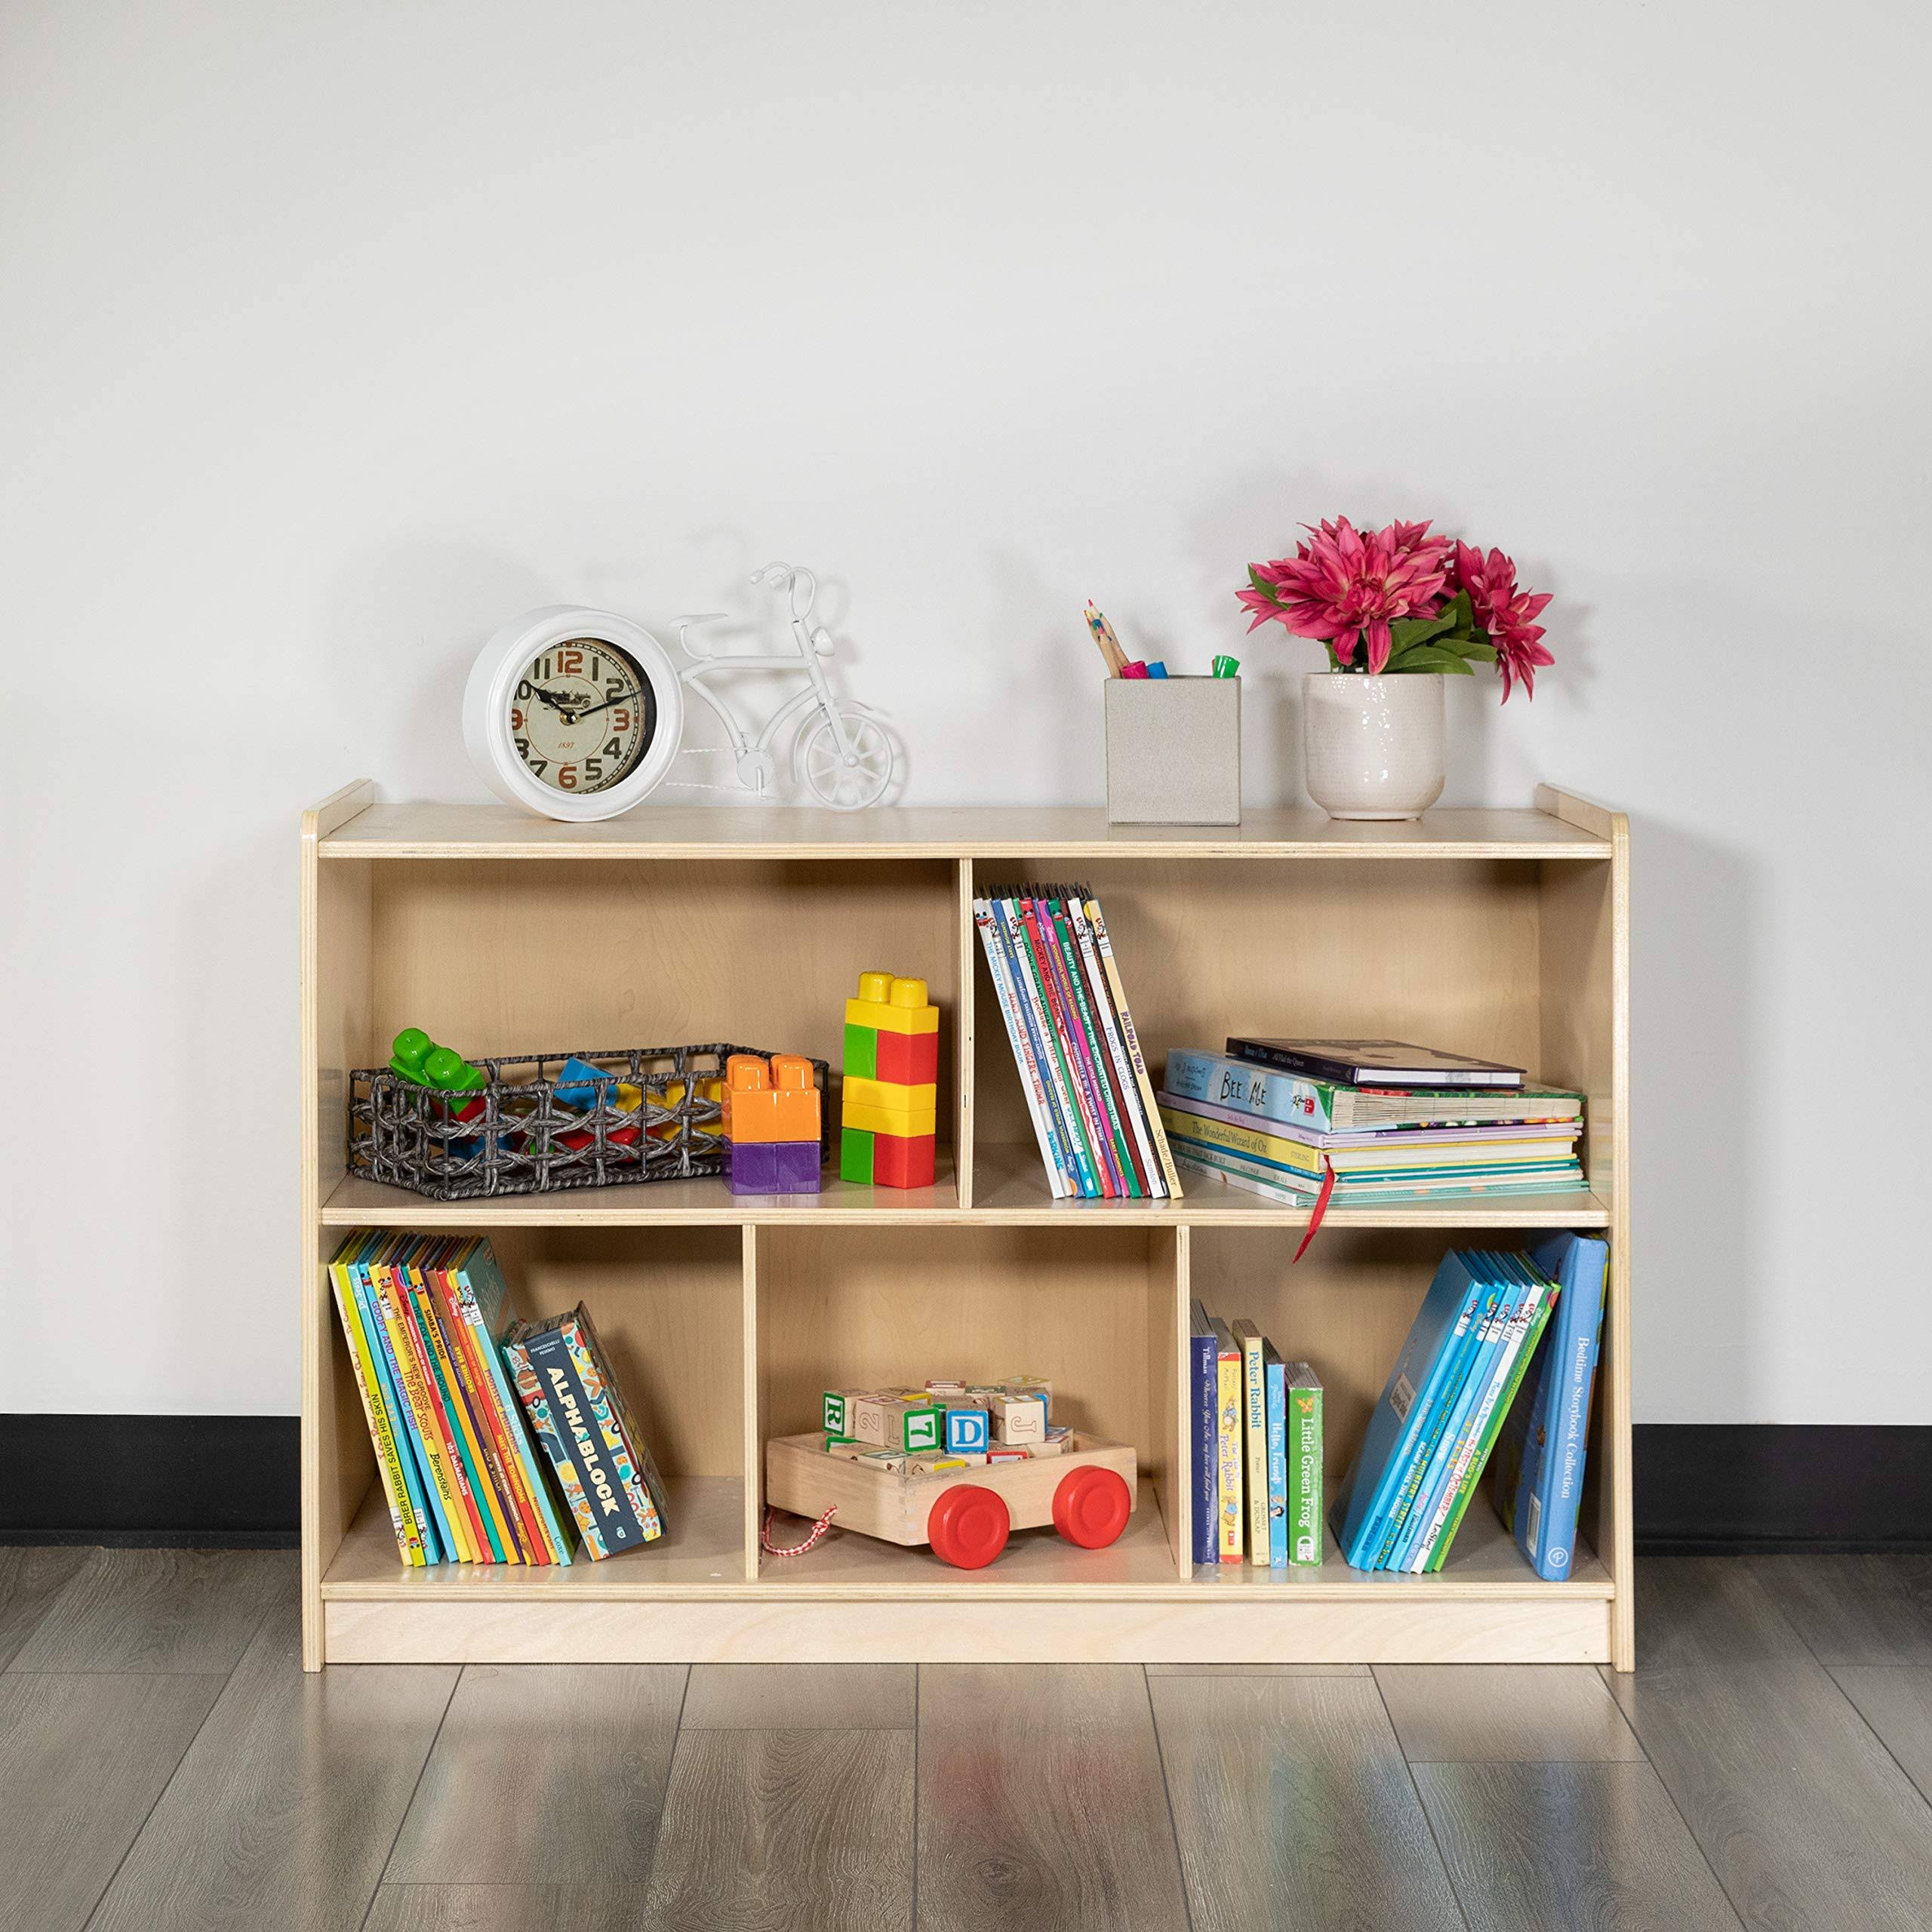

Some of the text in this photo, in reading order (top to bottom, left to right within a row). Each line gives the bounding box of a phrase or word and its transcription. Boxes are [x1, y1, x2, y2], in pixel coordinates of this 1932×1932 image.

[534, 657, 550, 679] 11
[557, 651, 583, 674] 12
[592, 657, 598, 681] 1
[605, 678, 625, 701] 2
[511, 709, 523, 731] 9
[613, 709, 630, 731] 3
[557, 741, 575, 750] 1897
[602, 737, 623, 760] 4
[530, 760, 548, 778] 7
[558, 766, 577, 789] 6
[585, 758, 602, 780] 5
[1034, 938, 1046, 965] MICKEY
[1041, 966, 1051, 982] AND
[1063, 941, 1076, 970] BEAUTY
[1070, 970, 1080, 986] AND
[986, 942, 1024, 1063] THE MICKEY MOUSE BIRTHDAY BOOK
[1106, 1026, 1129, 1091] FROGS IN CLOGS
[1120, 1010, 1145, 1075] RAILROAD TOAD
[1087, 1097, 1097, 1116] TWIST
[1155, 1128, 1180, 1189] Schade/Buller
[1258, 1140, 1267, 1153] Oz
[423, 1308, 446, 1360] SIMBA'S PRIDE
[371, 1300, 417, 1430] GOOFY AND THE MAGIC FISH
[392, 1306, 431, 1411] THE EMPEROR'S NEW GROOVE
[412, 1304, 451, 1403] THE FOX AND THE HOUND
[454, 1345, 475, 1394] BROTHER BEAR
[403, 1367, 417, 1388] The
[1248, 1352, 1261, 1428] Peter Rabbit
[408, 1387, 425, 1414] Bear
[827, 1400, 841, 1425] R
[508, 1413, 527, 1445] Sticks
[955, 1419, 981, 1444] D
[1560, 1336, 1589, 1499] Bedtime Storybook Collection
[546, 1369, 620, 1516] ALPHABLOCK
[1269, 1422, 1283, 1449] Hello,
[371, 1393, 412, 1524] BRER RABBIT SAVES HIS SKIN
[445, 1441, 468, 1496] 102 DALMATIANS
[497, 1433, 526, 1503] MEET THE ROBINSONS
[1220, 1434, 1234, 1491] Peter Rabbit
[1297, 1418, 1315, 1527] Little Green Frog
[1464, 1457, 1479, 1480] BUG'S
[429, 1451, 452, 1501] Berenstains
[1457, 1479, 1469, 1494] LIFE
[1392, 1459, 1429, 1529] MULBERRY STREET
[553, 1535, 566, 1555] Coxe
